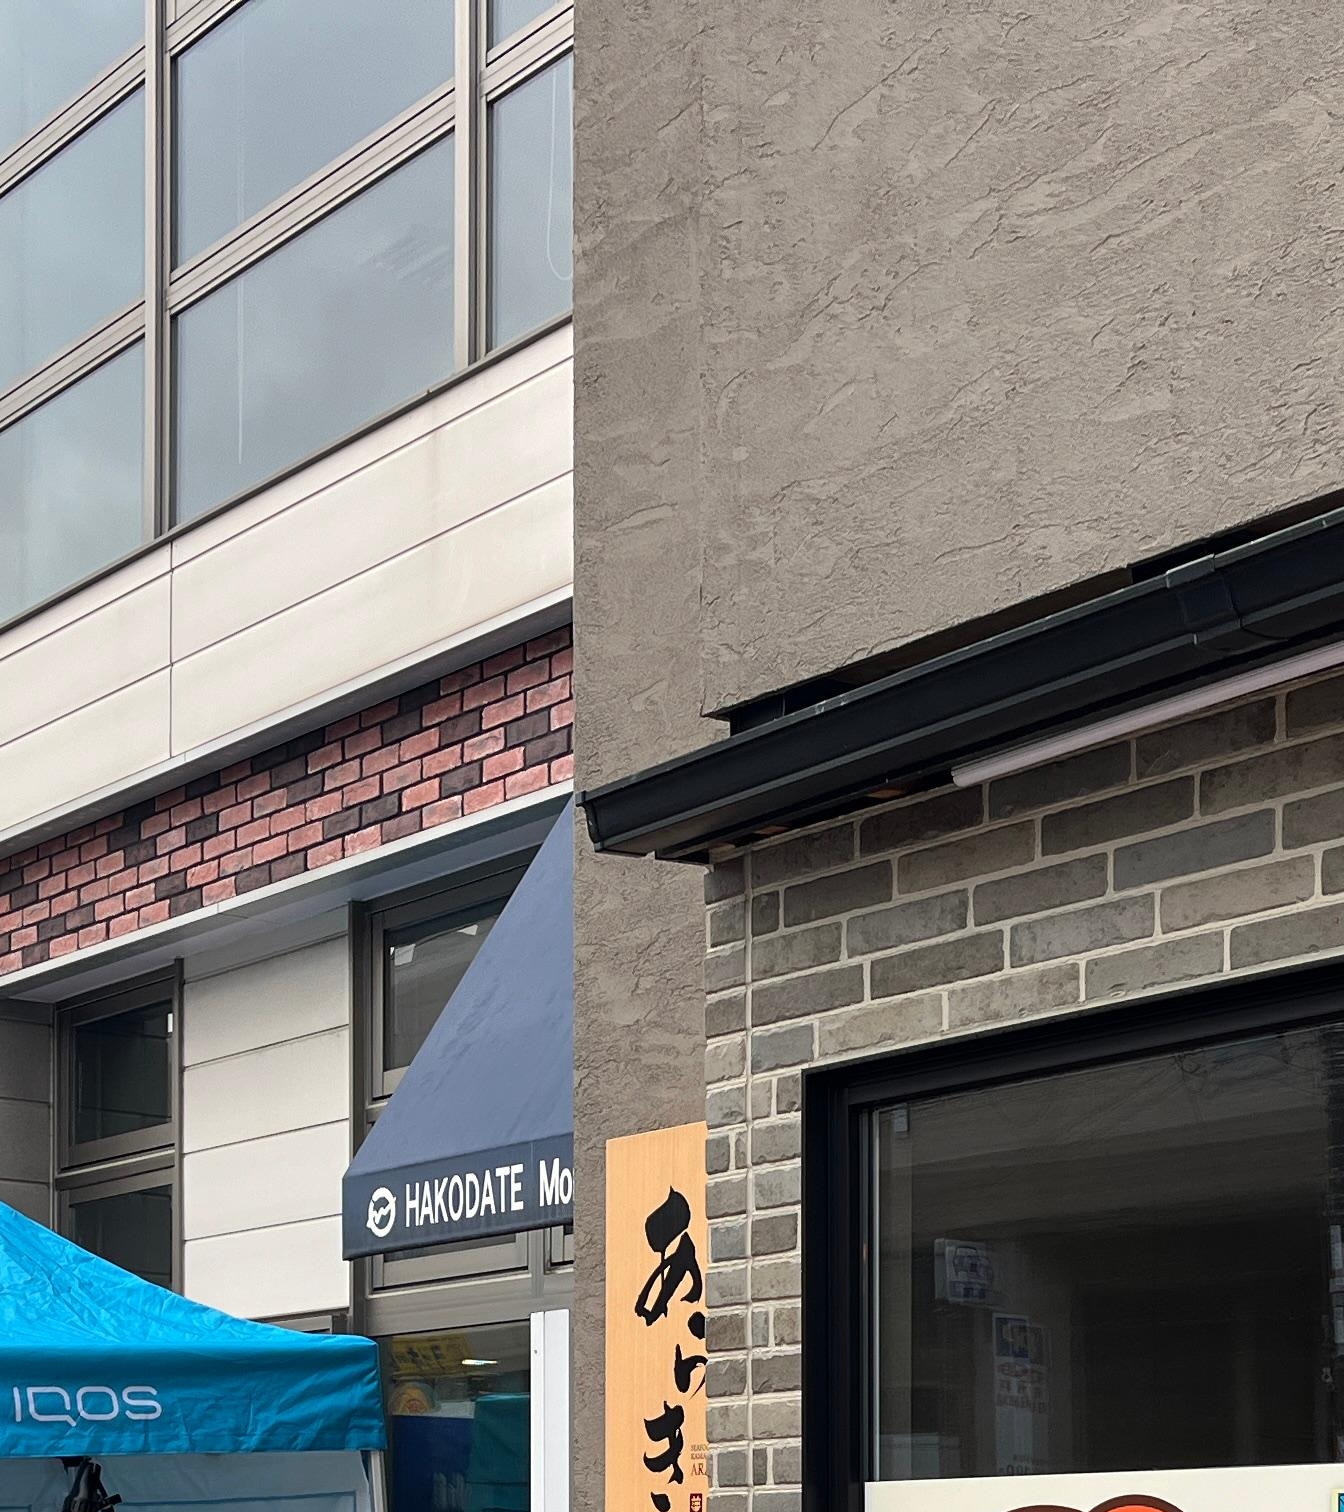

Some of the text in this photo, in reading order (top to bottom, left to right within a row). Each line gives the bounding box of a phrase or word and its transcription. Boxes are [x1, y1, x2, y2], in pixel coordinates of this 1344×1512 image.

[405, 1157, 574, 1228] HAKODATE Mo
[12, 1385, 163, 1427] IQOS
